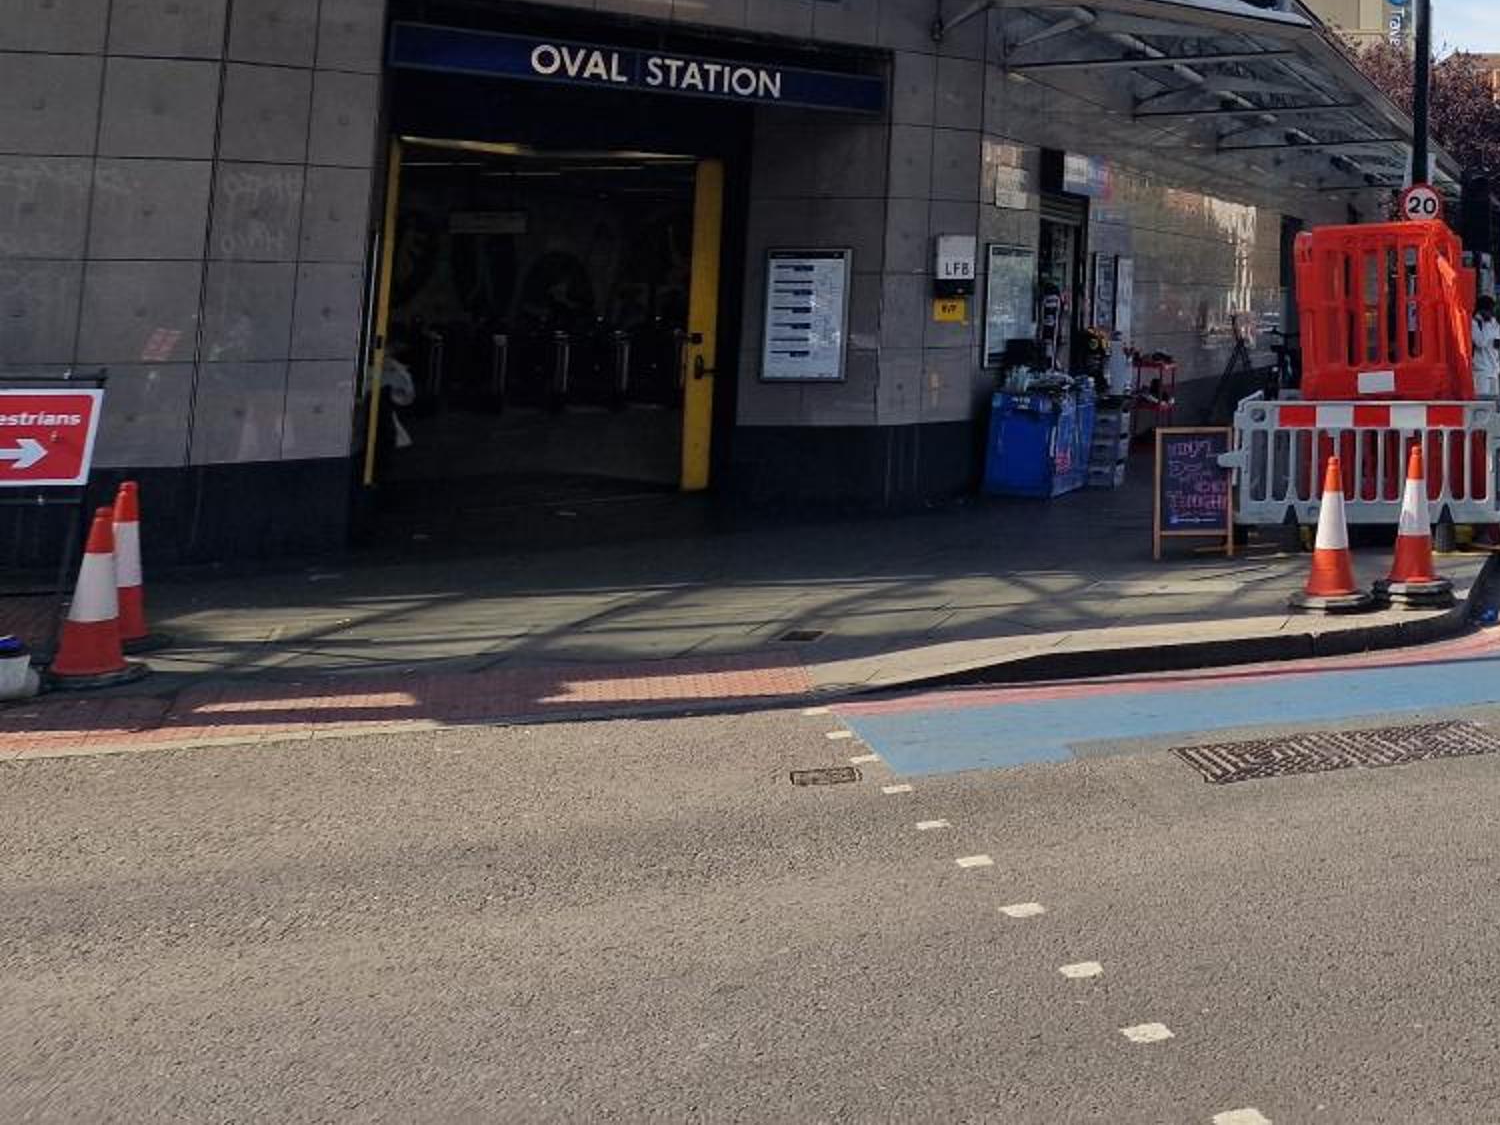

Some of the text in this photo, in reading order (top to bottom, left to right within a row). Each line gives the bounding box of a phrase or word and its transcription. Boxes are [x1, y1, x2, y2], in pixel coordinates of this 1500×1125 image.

[1389, 7, 1405, 47] Trave
[530, 43, 782, 99] OVAL STATION
[1408, 196, 1437, 214] 20
[0, 411, 81, 426] estrians
